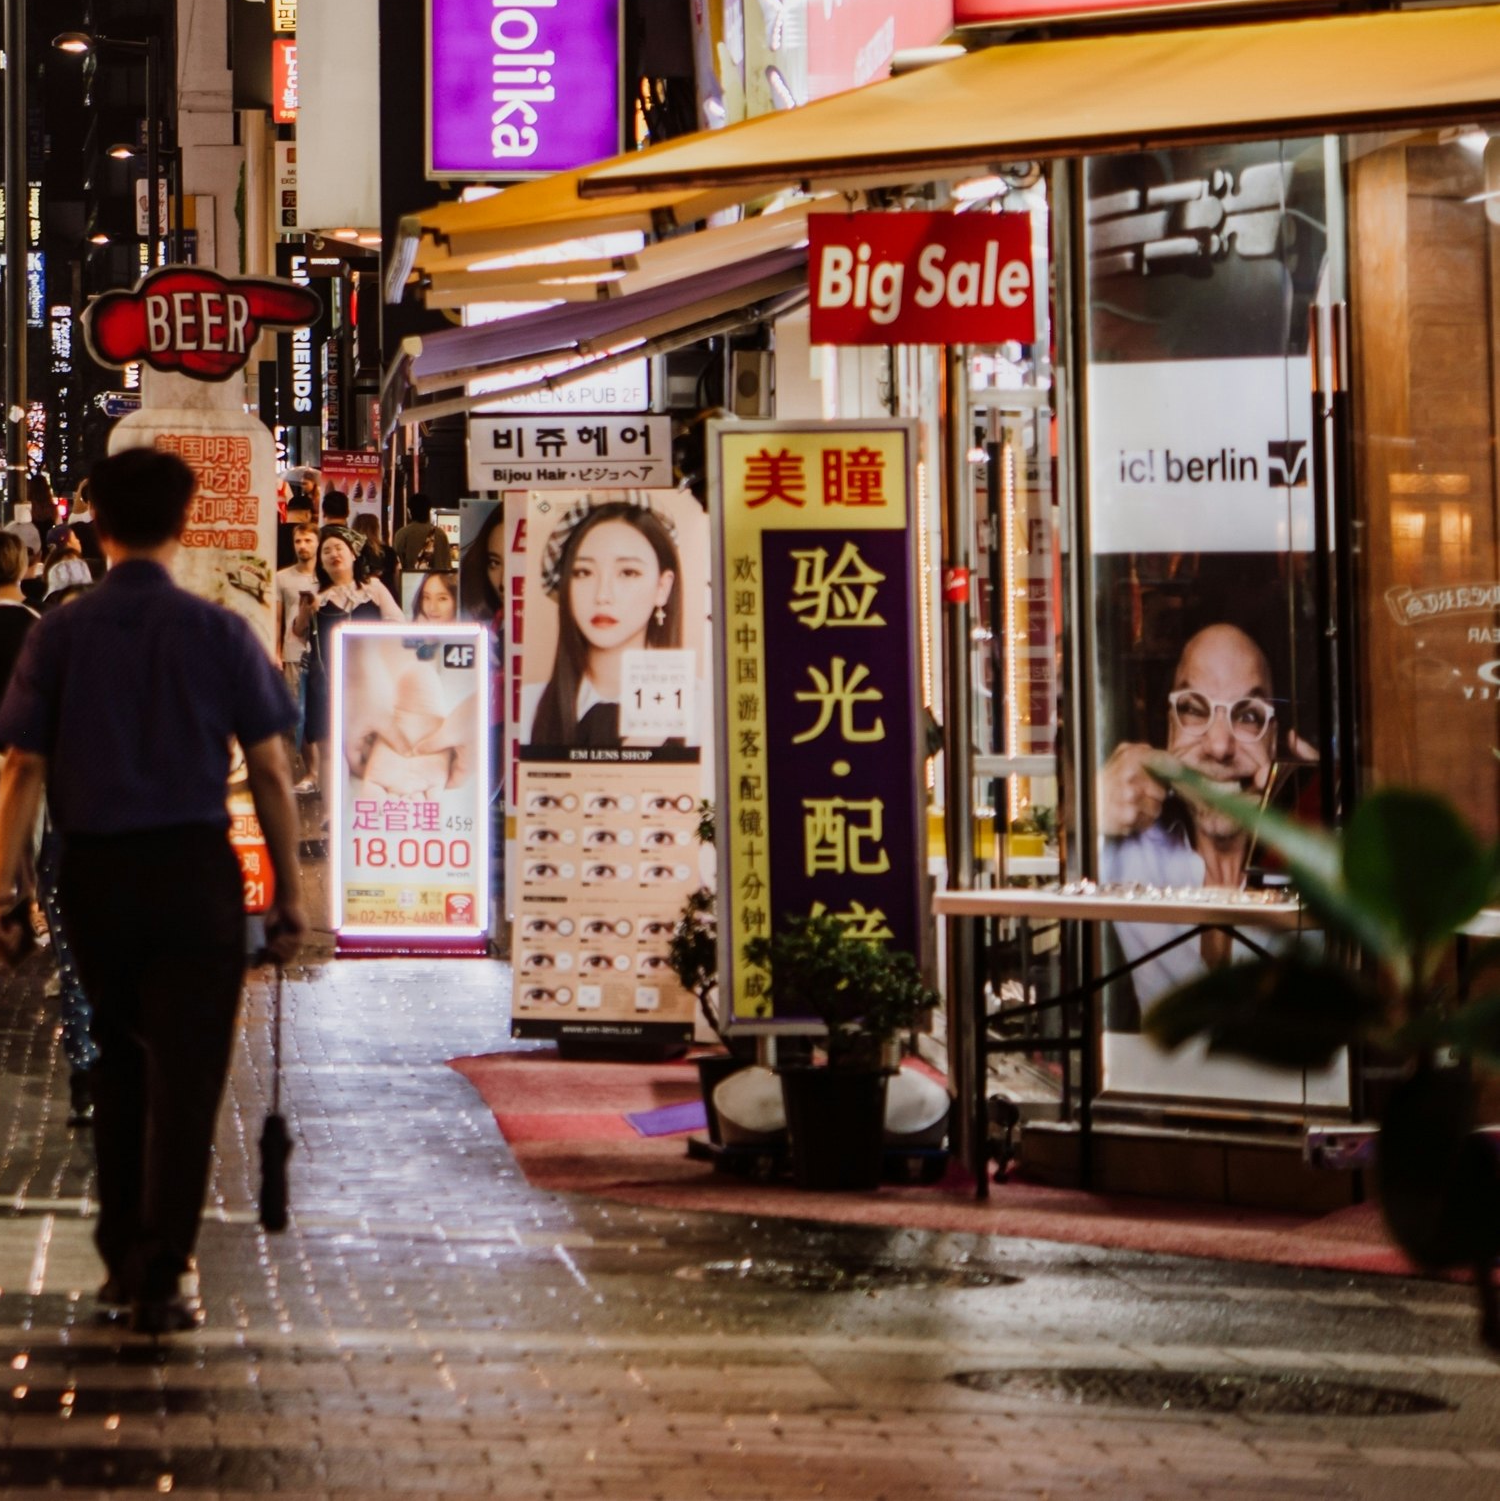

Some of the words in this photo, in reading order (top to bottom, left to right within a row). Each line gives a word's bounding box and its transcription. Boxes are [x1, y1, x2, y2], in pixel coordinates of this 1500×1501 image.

[817, 243, 904, 325] Big
[914, 240, 1032, 308] Sale
[144, 292, 250, 354] BEER
[293, 326, 311, 413] RIENDS
[579, 387, 617, 404] PUB
[493, 424, 651, 458] 비쥬헤어
[493, 468, 532, 484] Bijou
[536, 468, 566, 482] Hair
[744, 447, 887, 508] 美瞳
[1118, 447, 1157, 485] ic!
[1165, 448, 1258, 485] berlin
[190, 495, 259, 525] 和啤酒
[446, 646, 475, 666] 4F
[570, 750, 588, 761] EM
[591, 750, 619, 761] LENS
[621, 750, 653, 762] SHOP
[352, 800, 440, 833] 足管理
[352, 838, 471, 870] 18.000
[244, 884, 267, 908] 21
